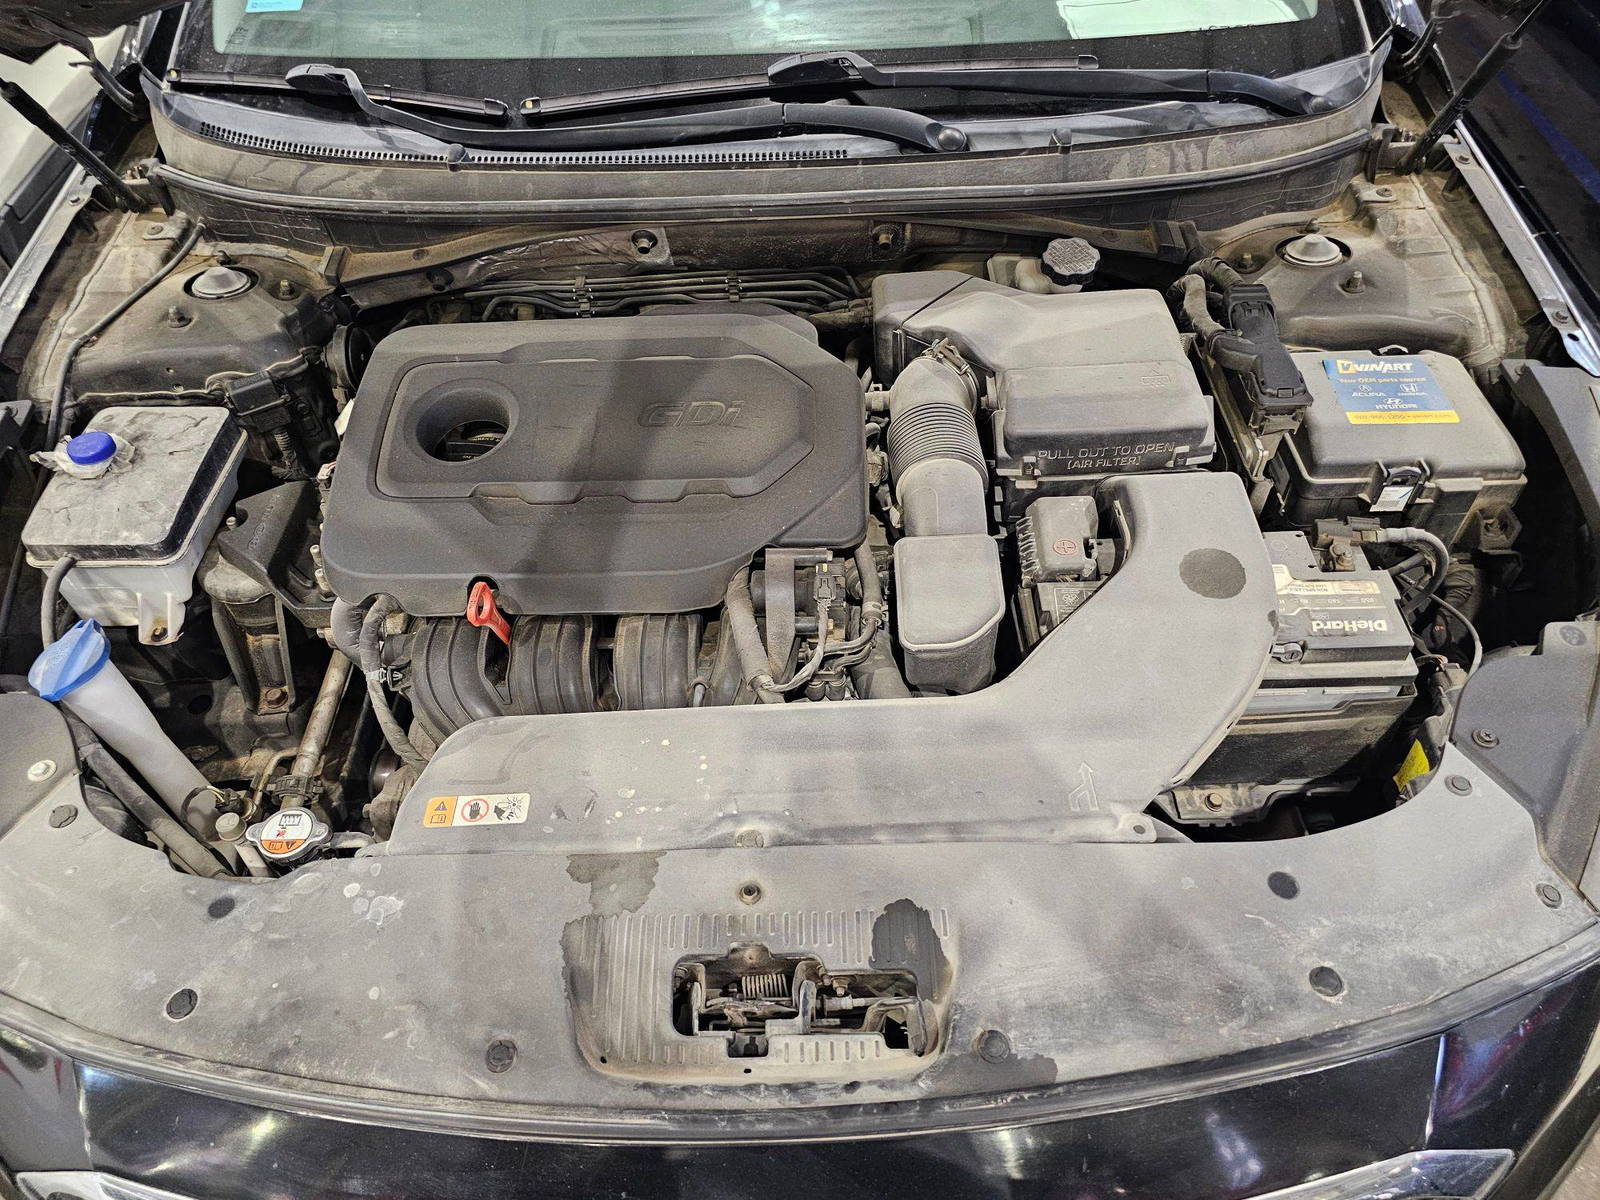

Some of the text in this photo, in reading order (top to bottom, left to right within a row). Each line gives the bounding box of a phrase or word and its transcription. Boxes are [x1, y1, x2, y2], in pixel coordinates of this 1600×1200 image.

[1037, 442, 1175, 460] PULL OUT TO OPEN
[1311, 619, 1387, 632] DieHard
